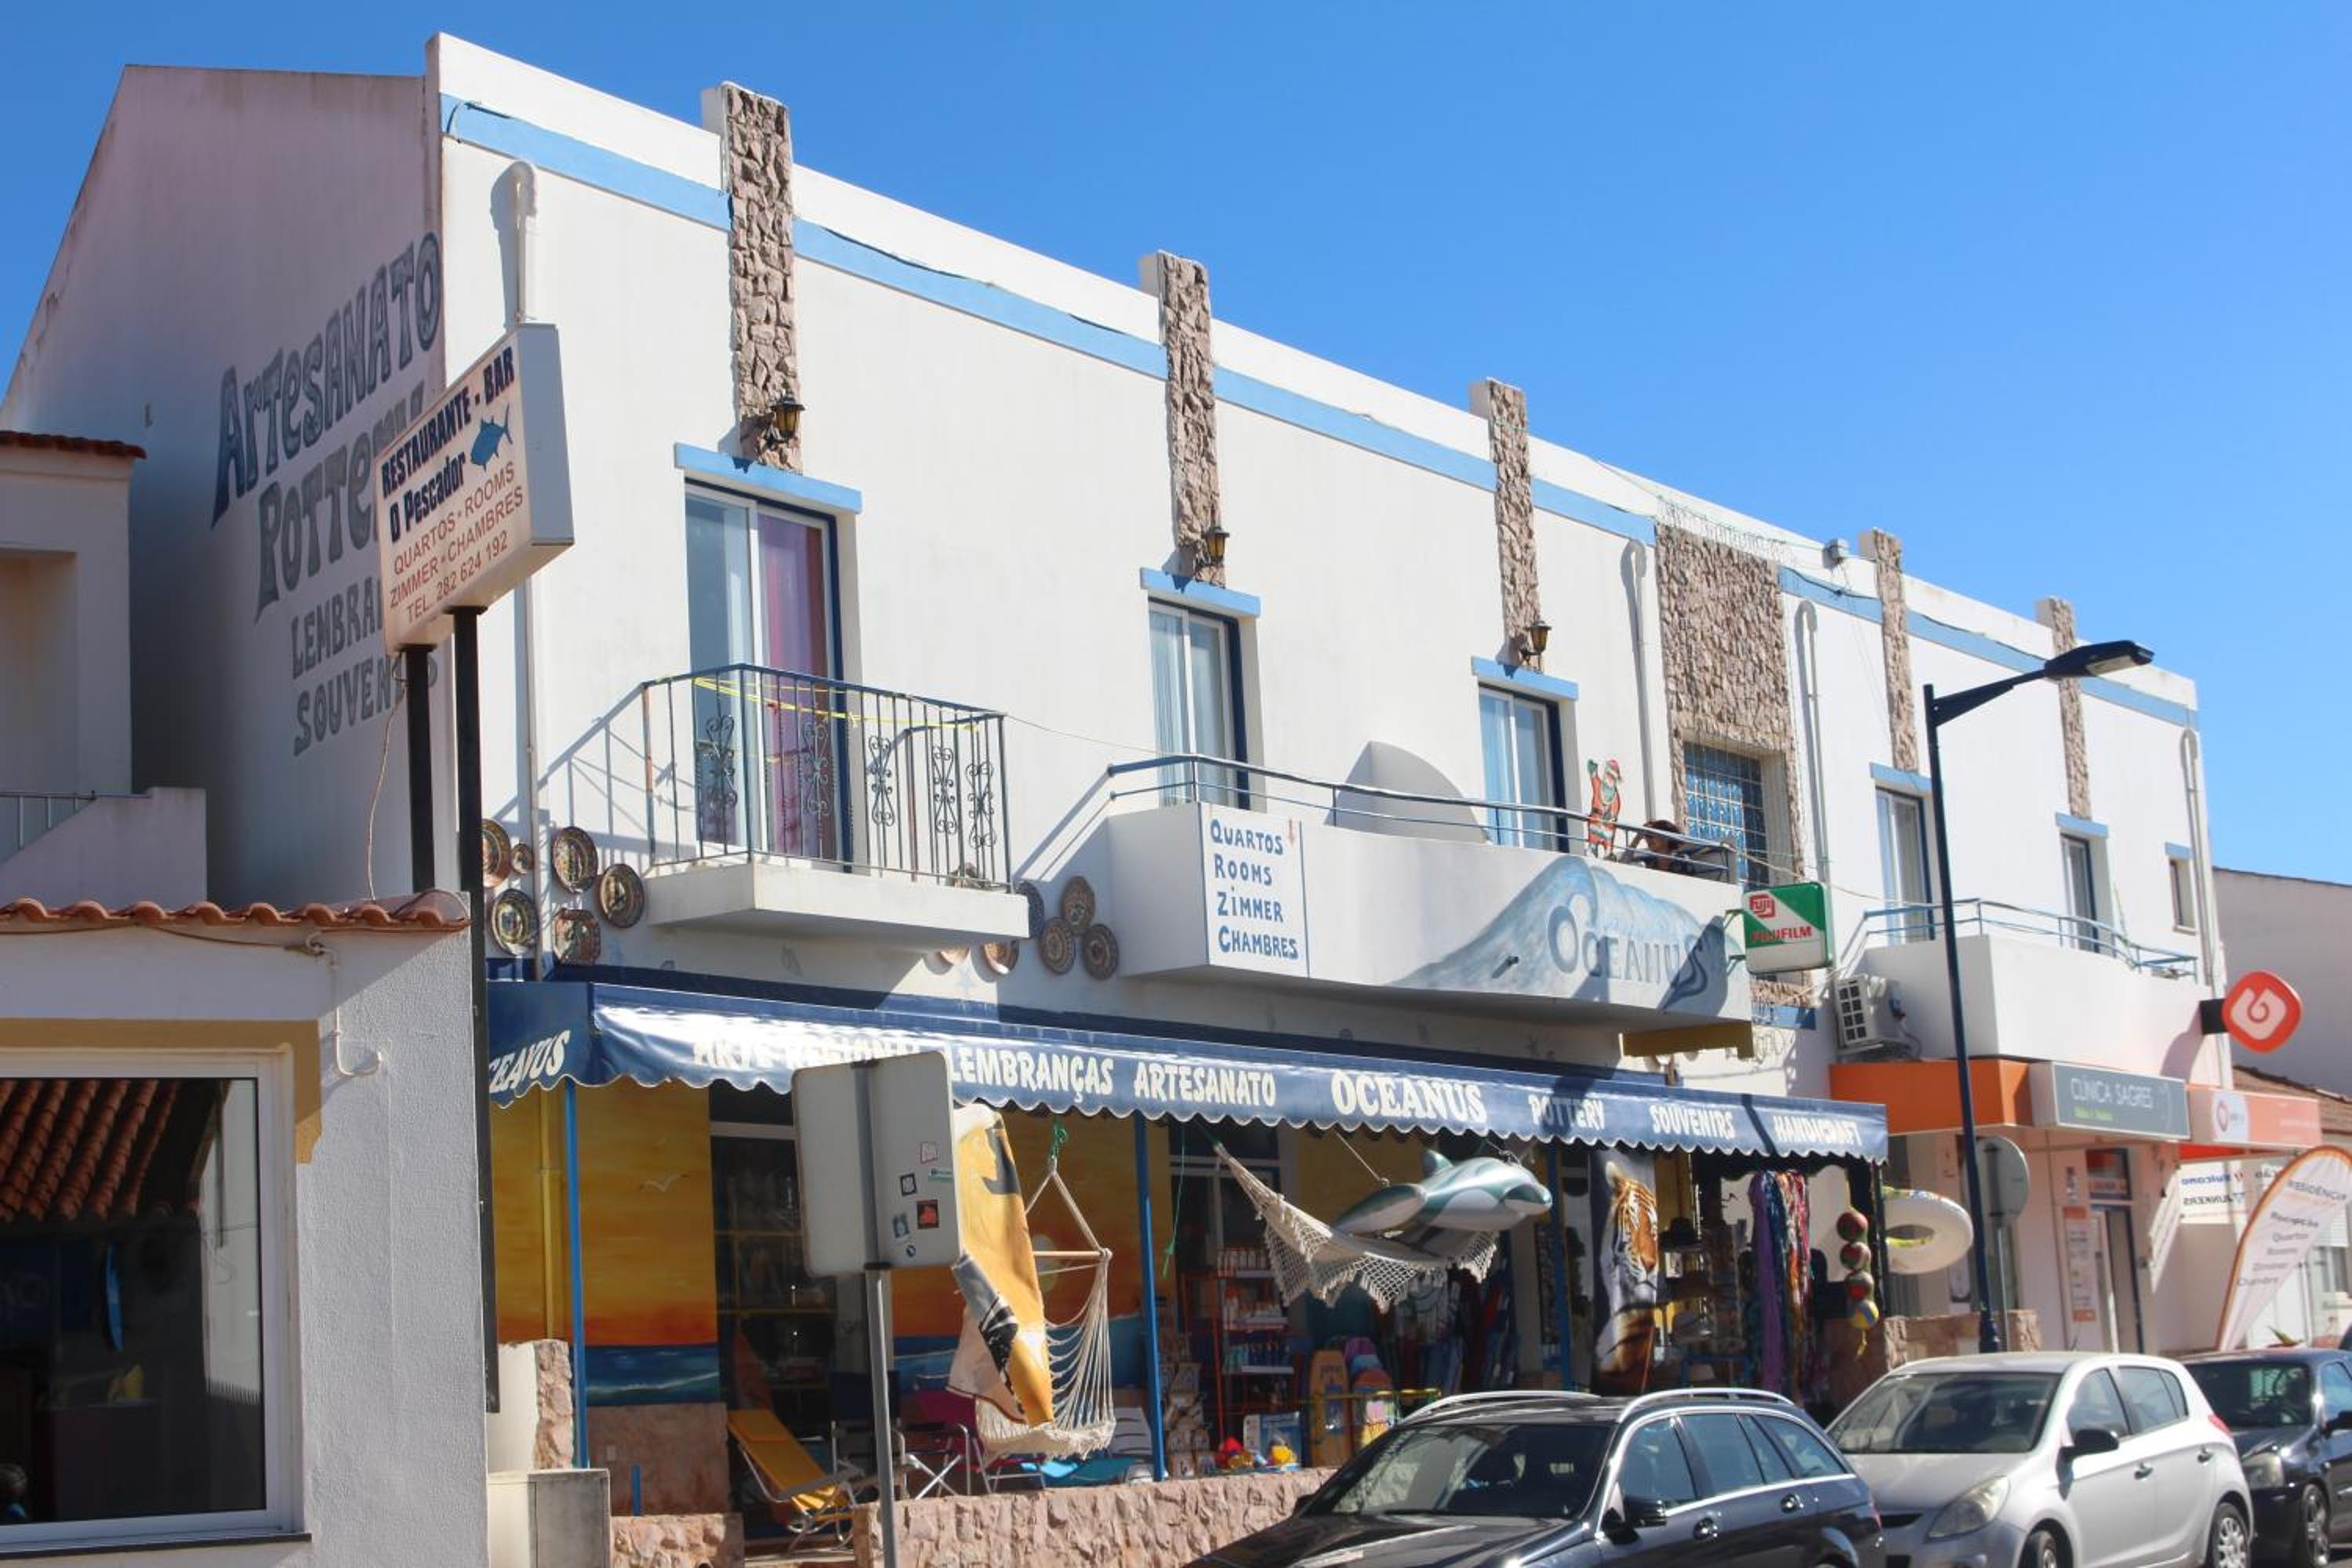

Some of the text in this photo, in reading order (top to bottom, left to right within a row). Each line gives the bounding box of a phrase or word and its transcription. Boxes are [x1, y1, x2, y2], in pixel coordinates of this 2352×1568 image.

[381, 385, 471, 499] RESTAURANTE
[483, 346, 515, 406] BAR
[389, 450, 467, 543] O Pescador
[394, 510, 456, 575] QUARTOS
[464, 460, 516, 517] ROOMS
[389, 556, 438, 609] ZIMMER
[448, 485, 524, 563] CHAMBRES
[436, 573, 457, 601] 282
[459, 556, 482, 584] 624
[486, 529, 509, 560] 192
[1210, 819, 1283, 855] QUARTOS
[1214, 853, 1272, 886] ROOMS
[1218, 925, 1298, 960] CHAMBRES
[1751, 925, 1813, 942] FUJIFILM
[949, 1044, 1114, 1103] LEMBRANÇAS
[1134, 1058, 1276, 1107] ARTESANATO
[1331, 1069, 1487, 1123] OCEANUS
[1529, 1094, 1605, 1131] POTTERY
[1650, 1104, 1735, 1140] SOUVENIRS
